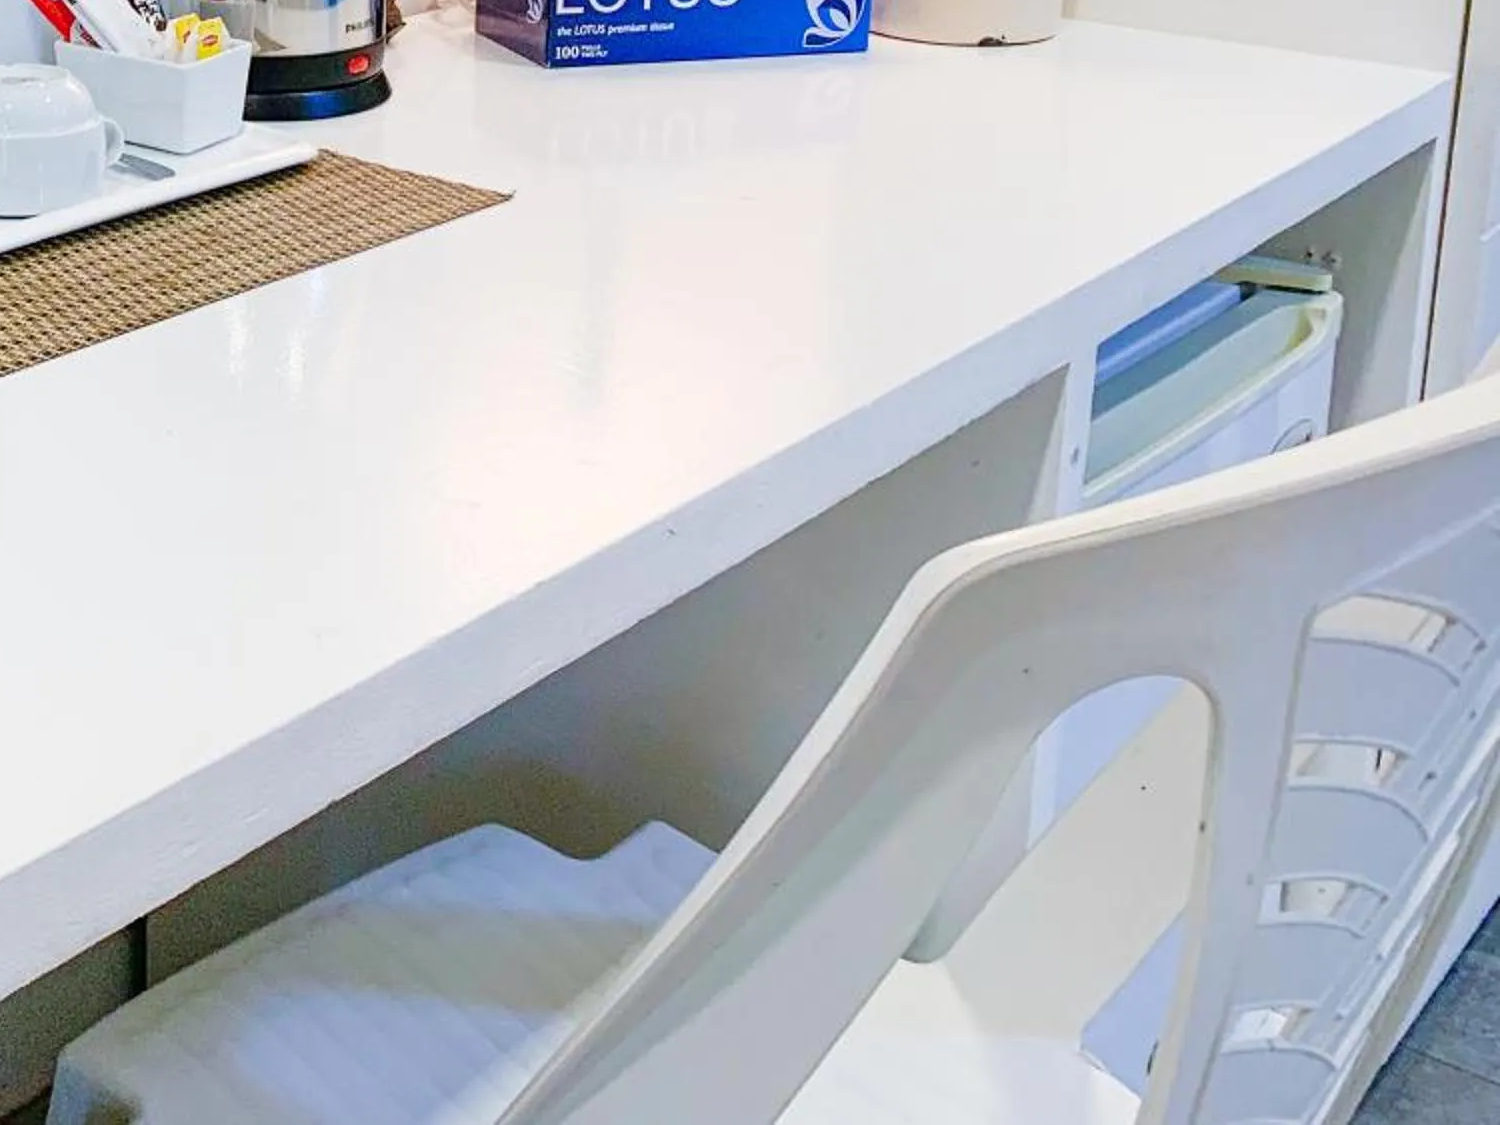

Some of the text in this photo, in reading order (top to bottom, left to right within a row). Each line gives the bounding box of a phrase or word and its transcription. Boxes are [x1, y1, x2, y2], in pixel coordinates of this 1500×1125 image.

[557, 25, 572, 36] the
[574, 23, 606, 36] LOTUS
[555, 45, 580, 60] 100
